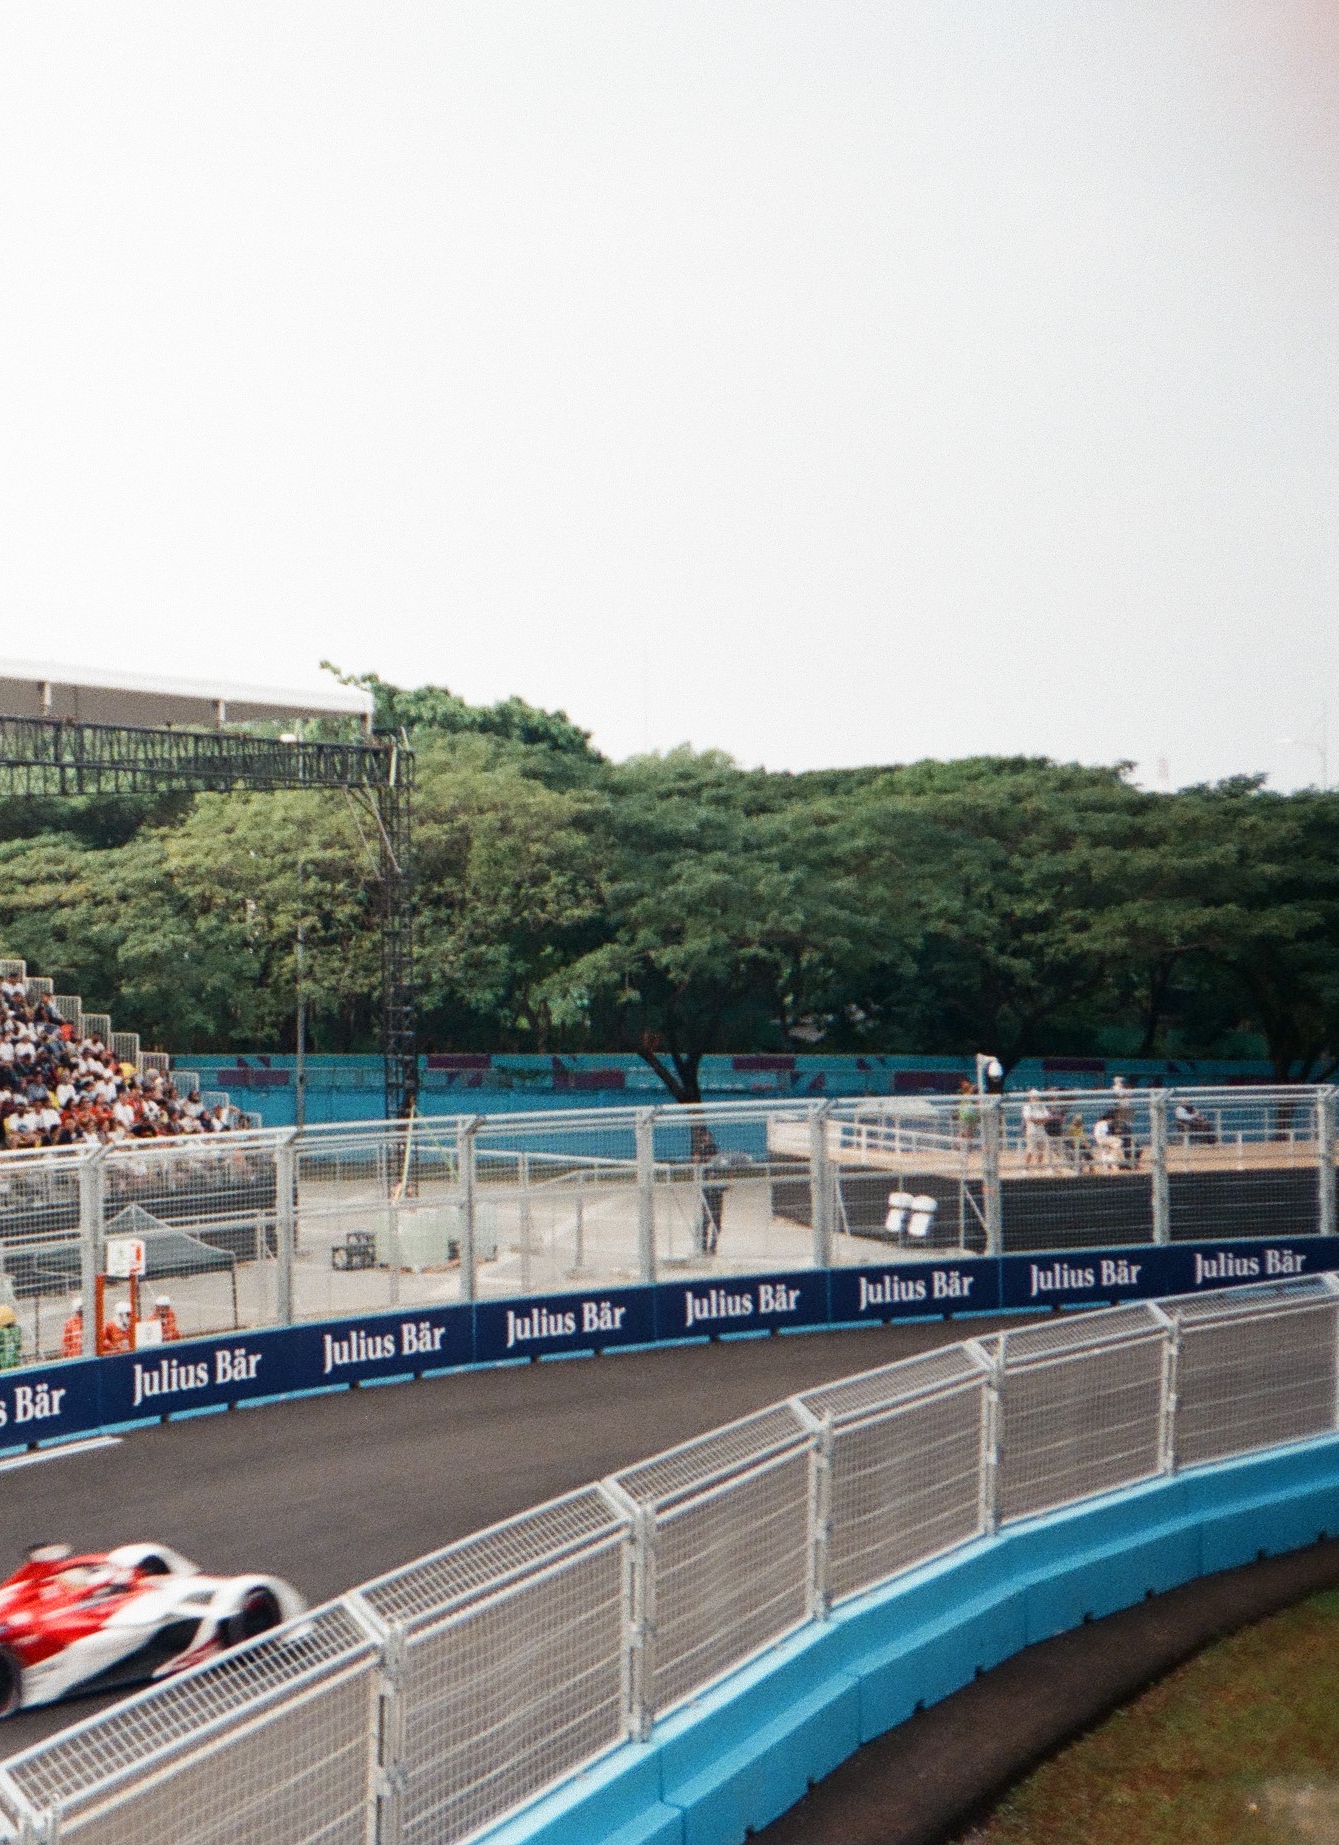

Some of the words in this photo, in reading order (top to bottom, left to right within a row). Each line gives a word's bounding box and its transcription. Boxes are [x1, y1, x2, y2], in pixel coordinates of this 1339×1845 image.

[1031, 1263, 1095, 1297] Julius
[1101, 1260, 1142, 1287] Bär
[1194, 1252, 1260, 1285] Julius
[1265, 1249, 1307, 1274] Bär
[686, 1290, 753, 1327] Julius
[759, 1284, 801, 1314] Bär
[859, 1275, 927, 1311] Julius
[932, 1271, 974, 1299] Bär
[507, 1308, 576, 1348] Julius
[583, 1301, 626, 1333] Bär
[324, 1330, 396, 1374] Julius
[401, 1321, 446, 1356] Bär
[133, 1359, 209, 1406] Julius
[215, 1348, 262, 1385] Bär
[14, 1383, 66, 1423] Bär
